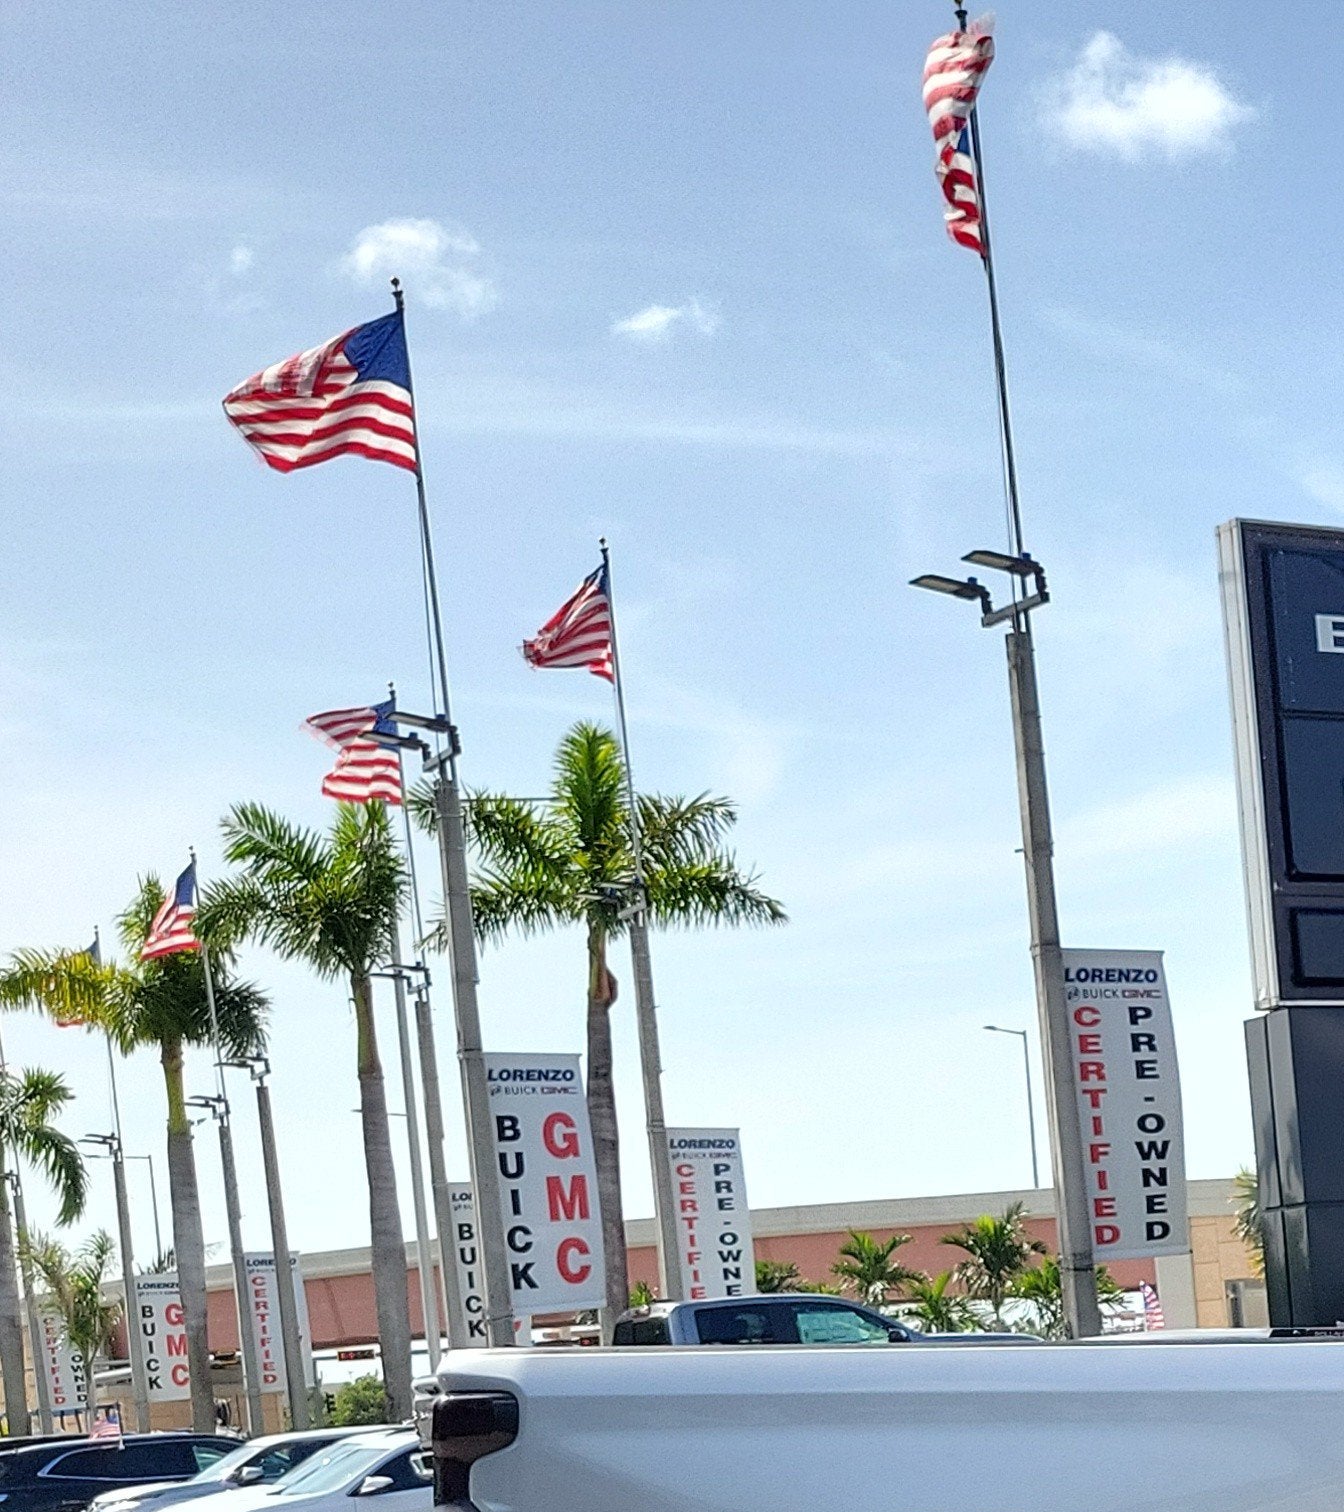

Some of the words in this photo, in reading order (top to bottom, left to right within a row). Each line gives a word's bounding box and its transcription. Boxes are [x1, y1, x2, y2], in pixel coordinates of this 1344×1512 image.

[1064, 968, 1158, 983] LORENZO
[1082, 988, 1120, 999] BUICK
[488, 1068, 574, 1082] LORENZO
[504, 1085, 538, 1095] BUICK
[670, 1138, 736, 1150] LORENZO
[1074, 1006, 1120, 1245] CERTIFIED
[1128, 1005, 1171, 1241] PRE-OWNED
[496, 1115, 539, 1290] BUICK
[542, 1112, 592, 1284] GMC
[137, 1282, 179, 1291] LORENZ
[457, 1223, 487, 1338] BUICK
[141, 1305, 163, 1389] BUICK
[164, 1303, 190, 1387] GMC
